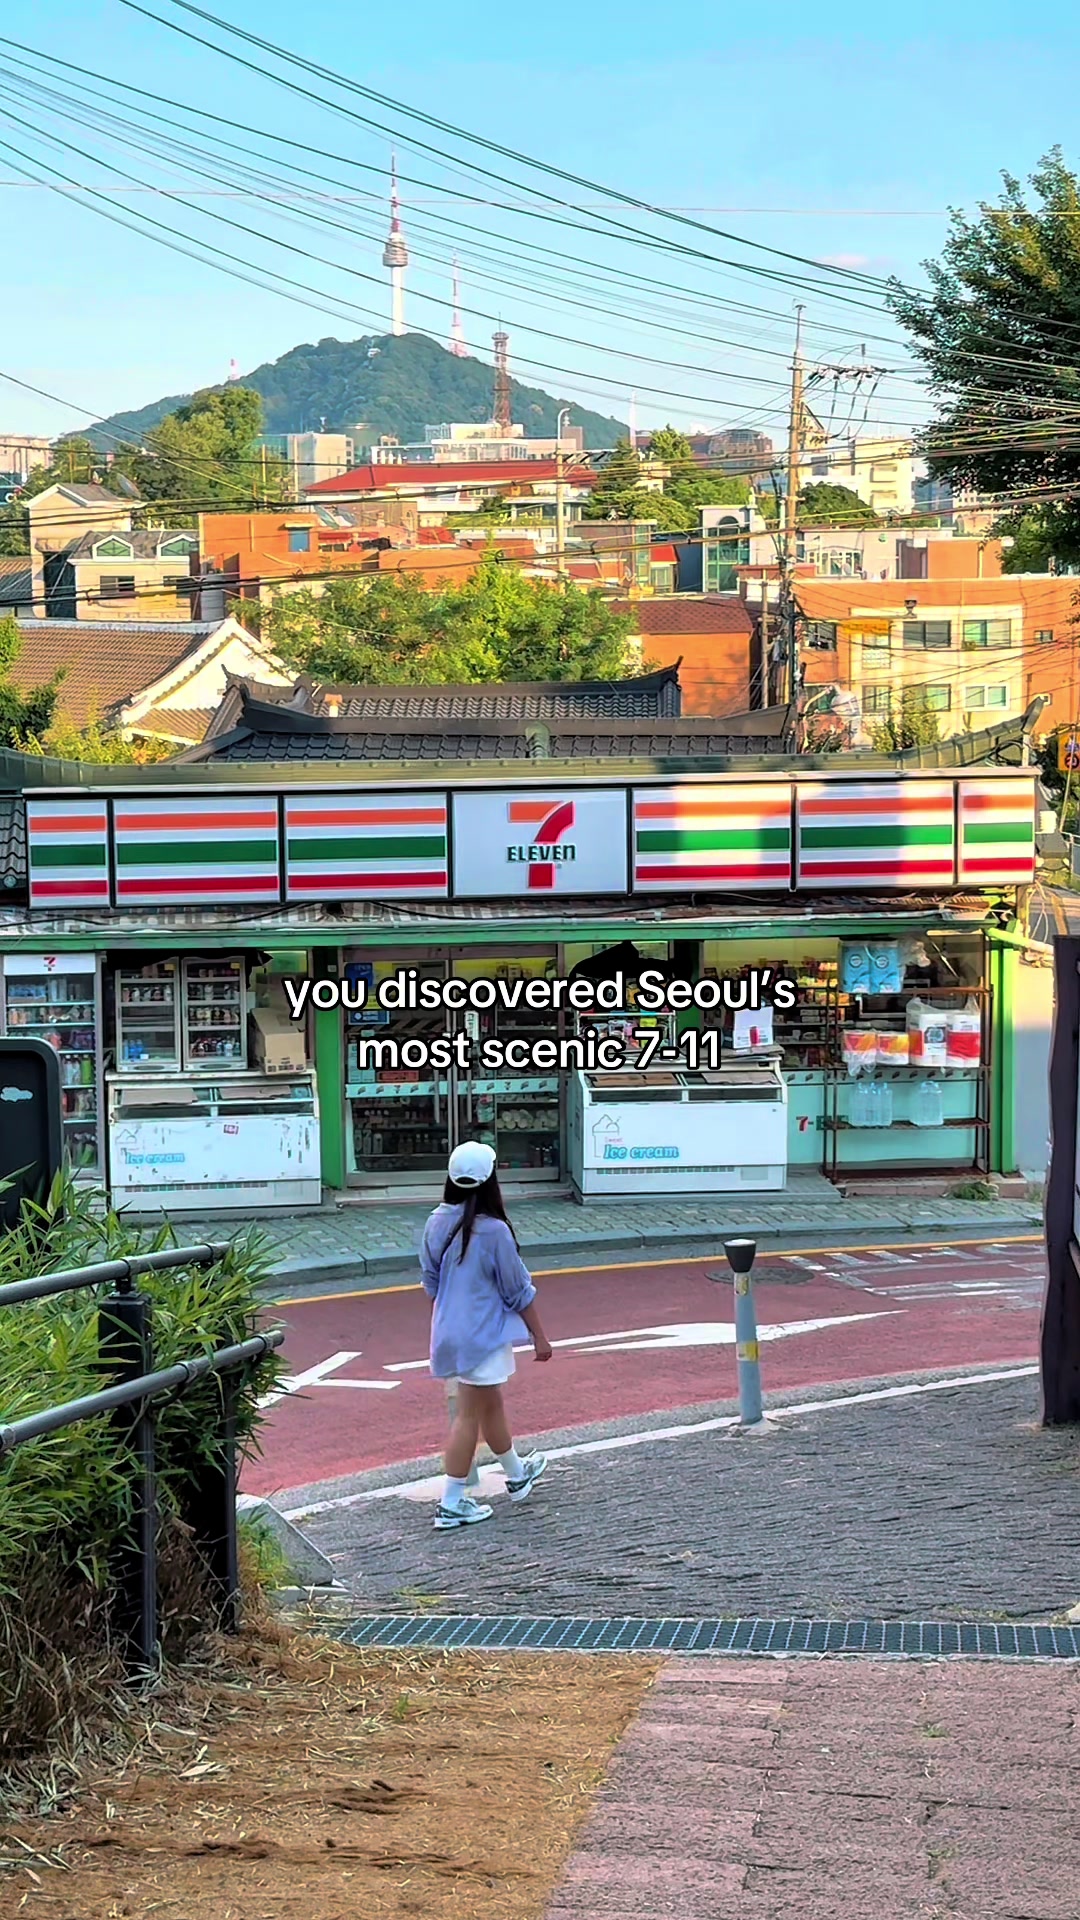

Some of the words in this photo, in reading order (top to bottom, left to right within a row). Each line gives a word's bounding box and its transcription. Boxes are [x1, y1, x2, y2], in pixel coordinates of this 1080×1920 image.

[507, 800, 575, 889] 7
[603, 1144, 627, 1159] Ice
[629, 1146, 679, 1158] cream
